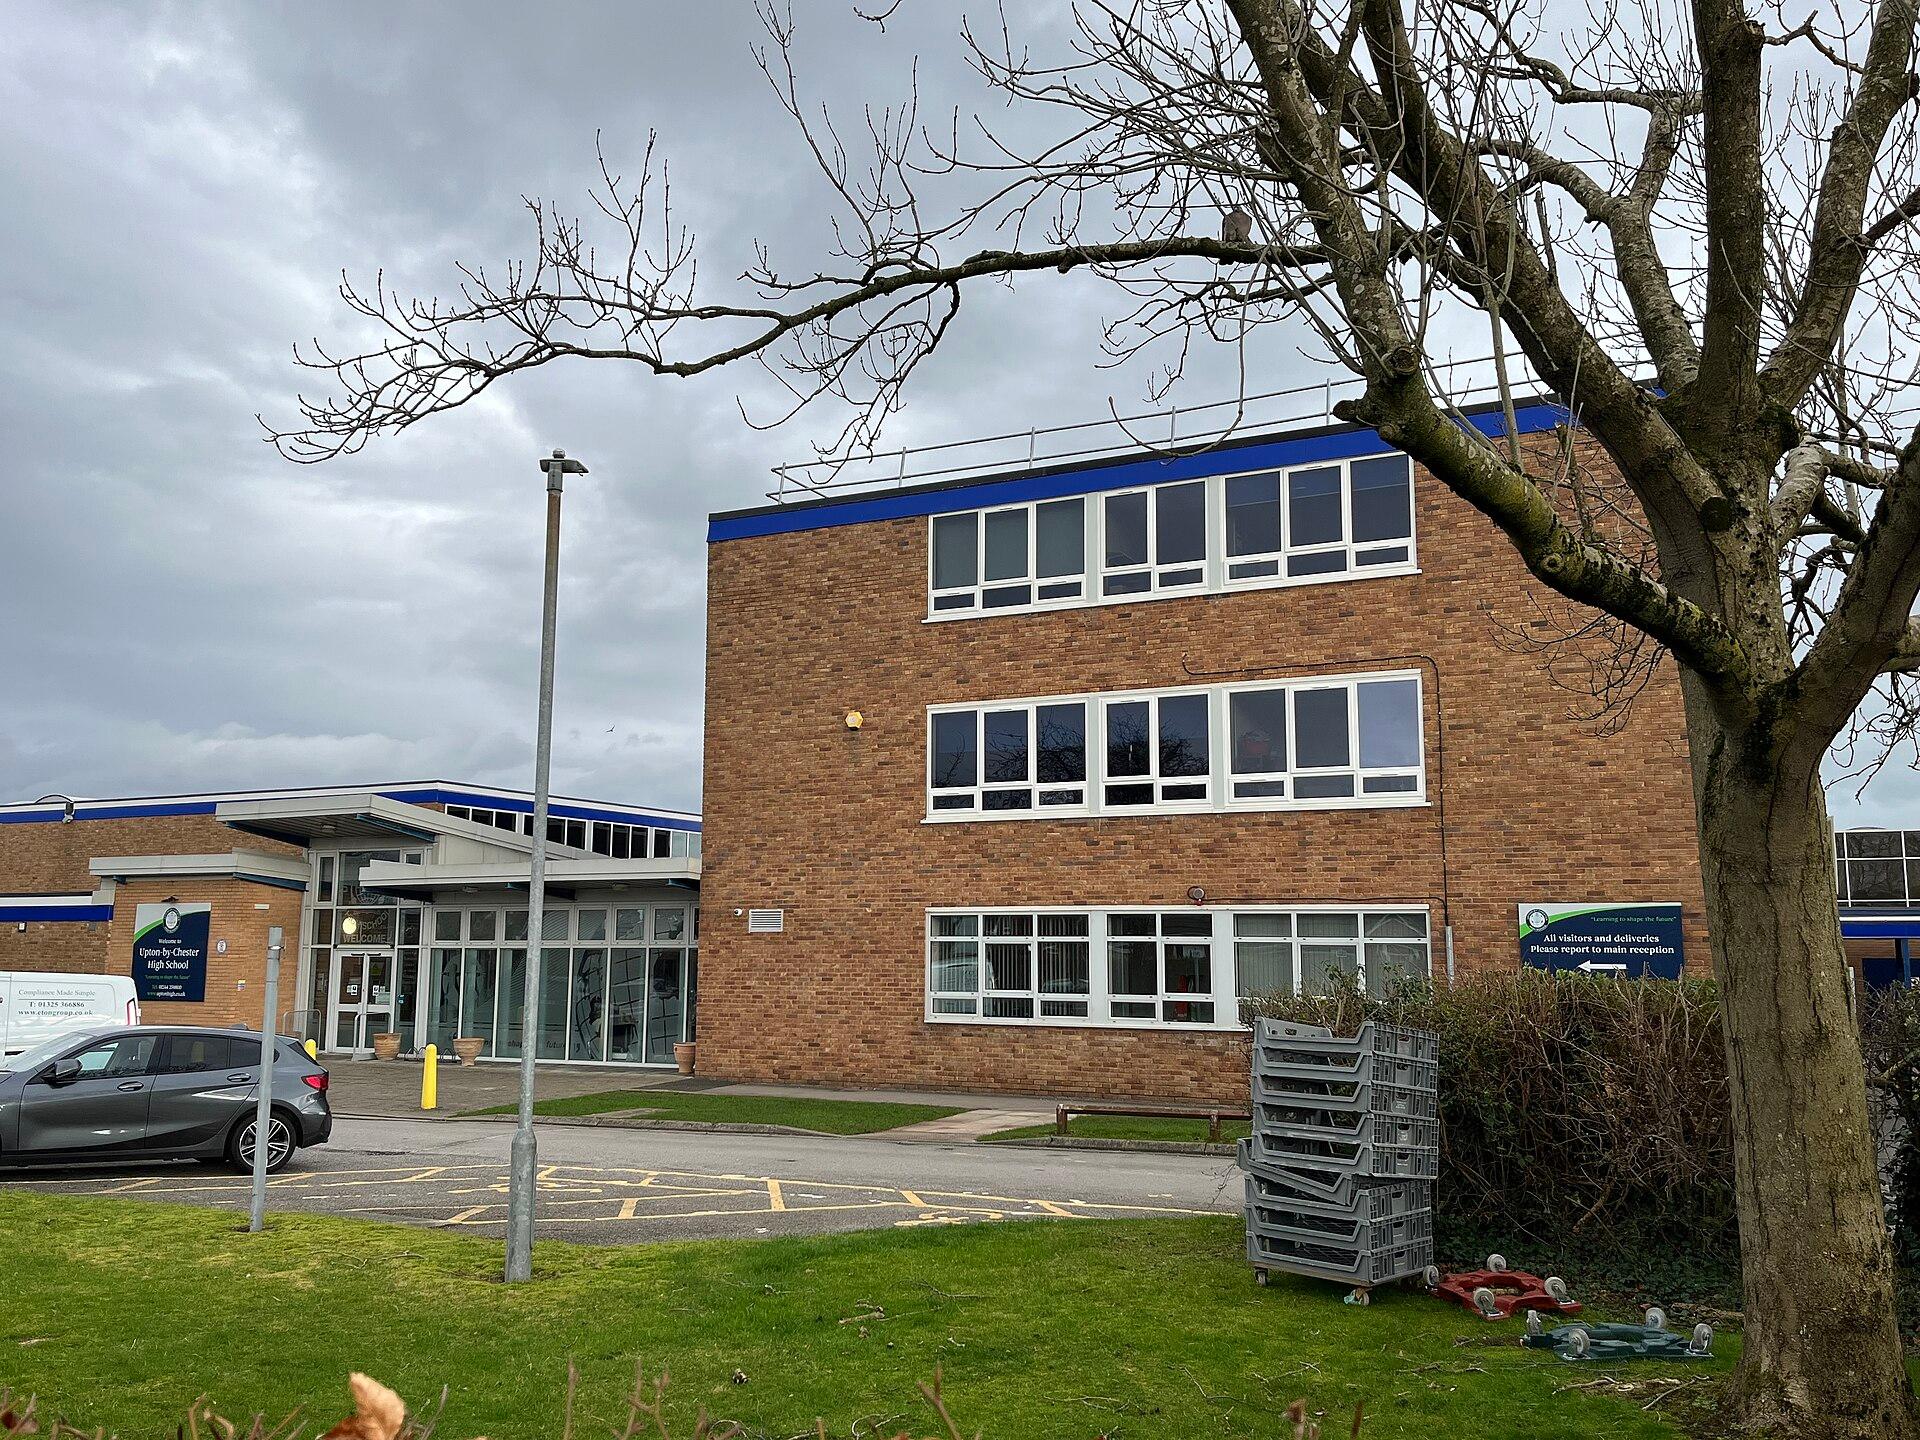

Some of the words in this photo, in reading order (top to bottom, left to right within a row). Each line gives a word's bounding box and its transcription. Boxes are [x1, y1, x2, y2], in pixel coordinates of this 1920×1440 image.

[343, 934, 386, 943] WELCOME
[1543, 934, 1557, 943] All
[1558, 934, 1593, 943] visitors
[1594, 934, 1613, 943] and
[1614, 934, 1660, 943] deliveries
[139, 947, 200, 959] Upton-by-Chester
[1530, 945, 1559, 954] Please
[1560, 945, 1590, 955] report
[1592, 945, 1601, 954] to
[1603, 945, 1626, 954] main
[1629, 945, 1675, 956] reception
[147, 960, 165, 971] High
[165, 960, 189, 969] School
[18, 989, 55, 997] Compliance
[74, 989, 96, 997] Simple
